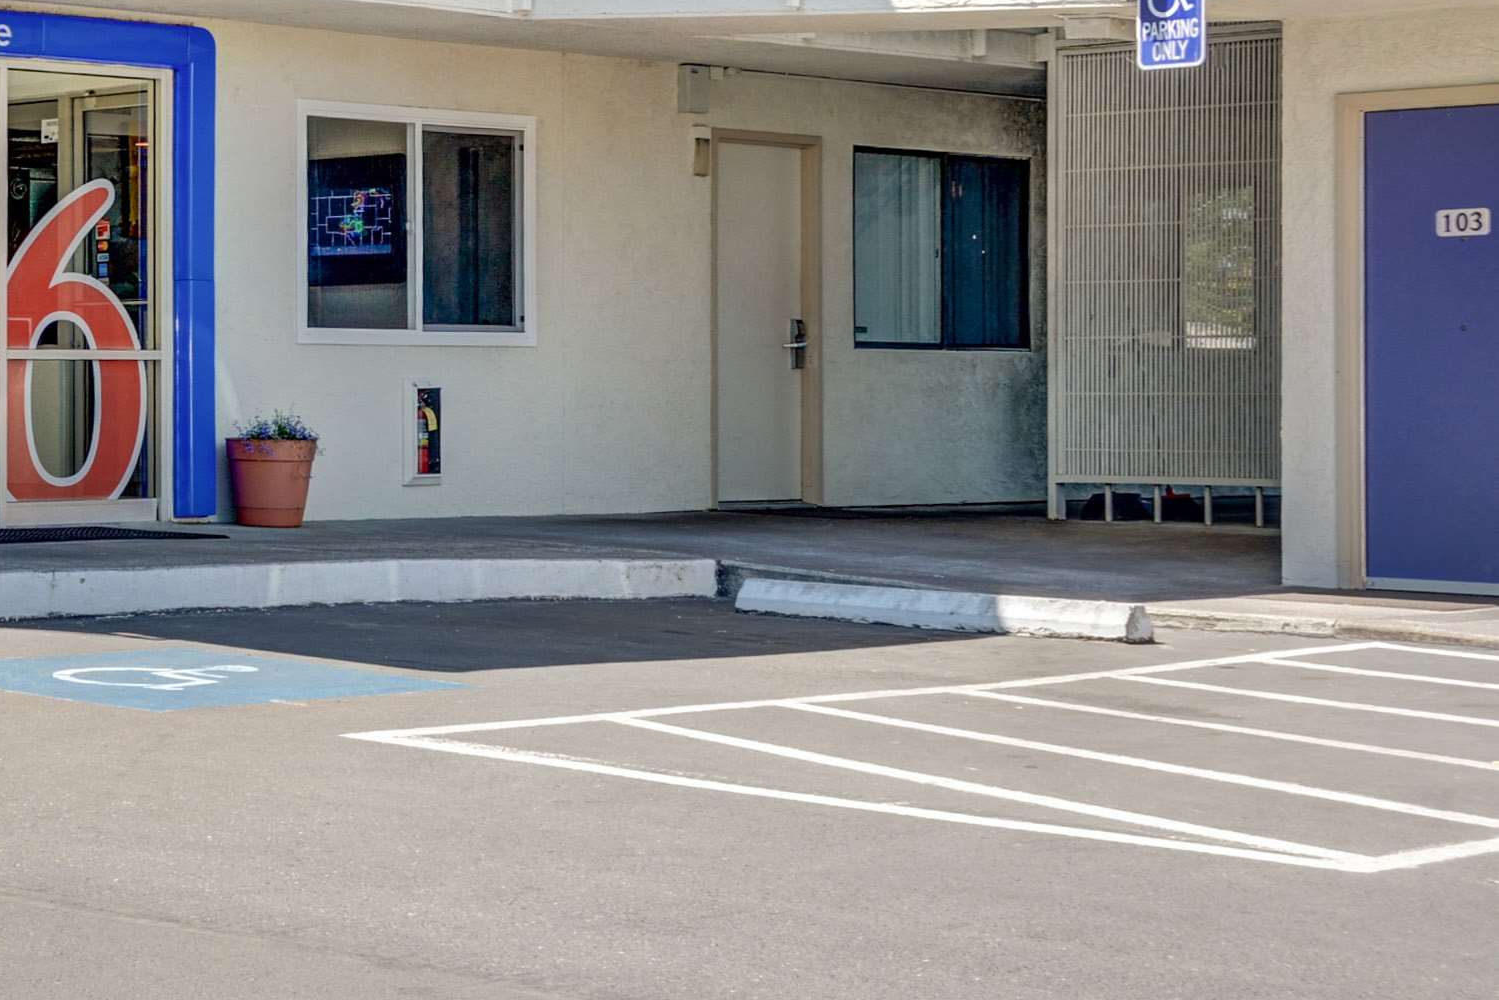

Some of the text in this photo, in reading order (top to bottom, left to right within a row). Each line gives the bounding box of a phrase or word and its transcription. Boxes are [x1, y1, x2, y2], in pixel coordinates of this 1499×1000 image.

[1142, 18, 1199, 41] PARKING
[1152, 39, 1189, 61] ONLY
[1443, 212, 1483, 232] 103
